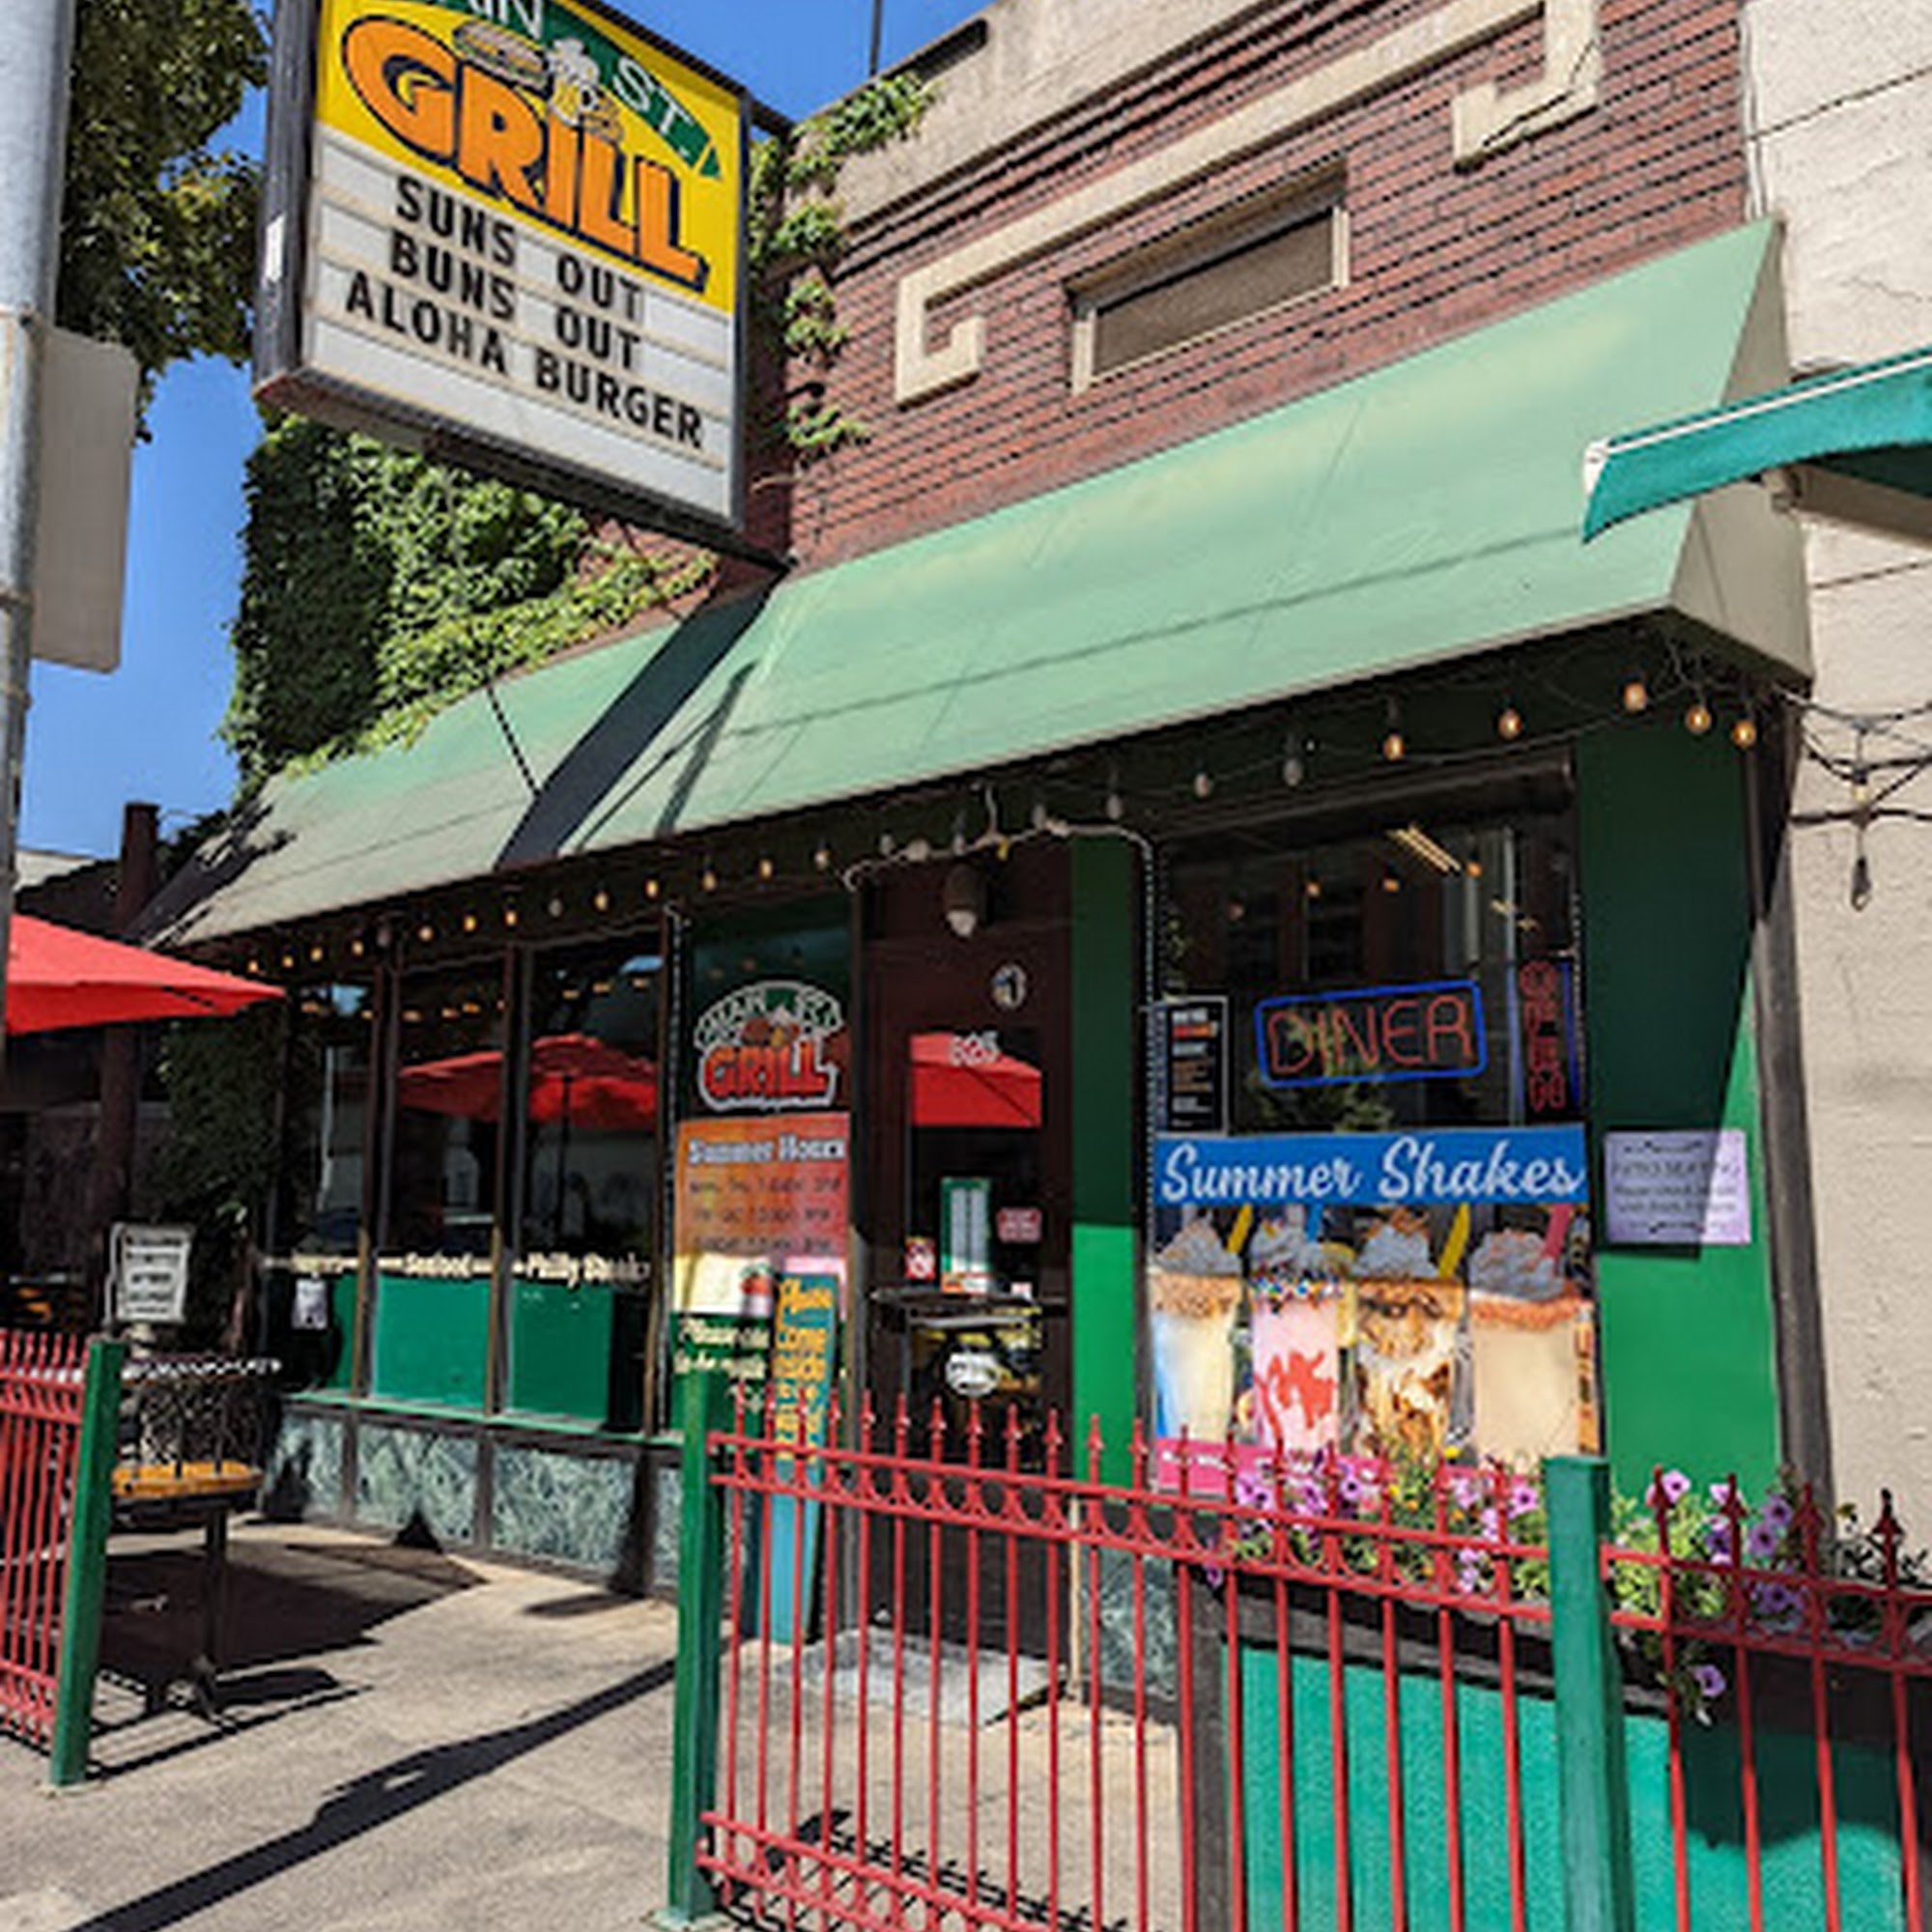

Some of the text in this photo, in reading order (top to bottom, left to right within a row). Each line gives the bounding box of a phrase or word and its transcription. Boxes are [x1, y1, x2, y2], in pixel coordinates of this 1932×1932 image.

[341, 14, 708, 293] GRILL
[389, 230, 641, 371] BUNS OUT
[395, 174, 644, 323] SUNS OUT
[344, 270, 703, 449] ALOHA BURGER
[703, 1038, 830, 1099] GRILL
[1267, 995, 1474, 1075] DINER
[1161, 1135, 1585, 1203] Summer Shakes
[526, 1252, 581, 1290] Philly
